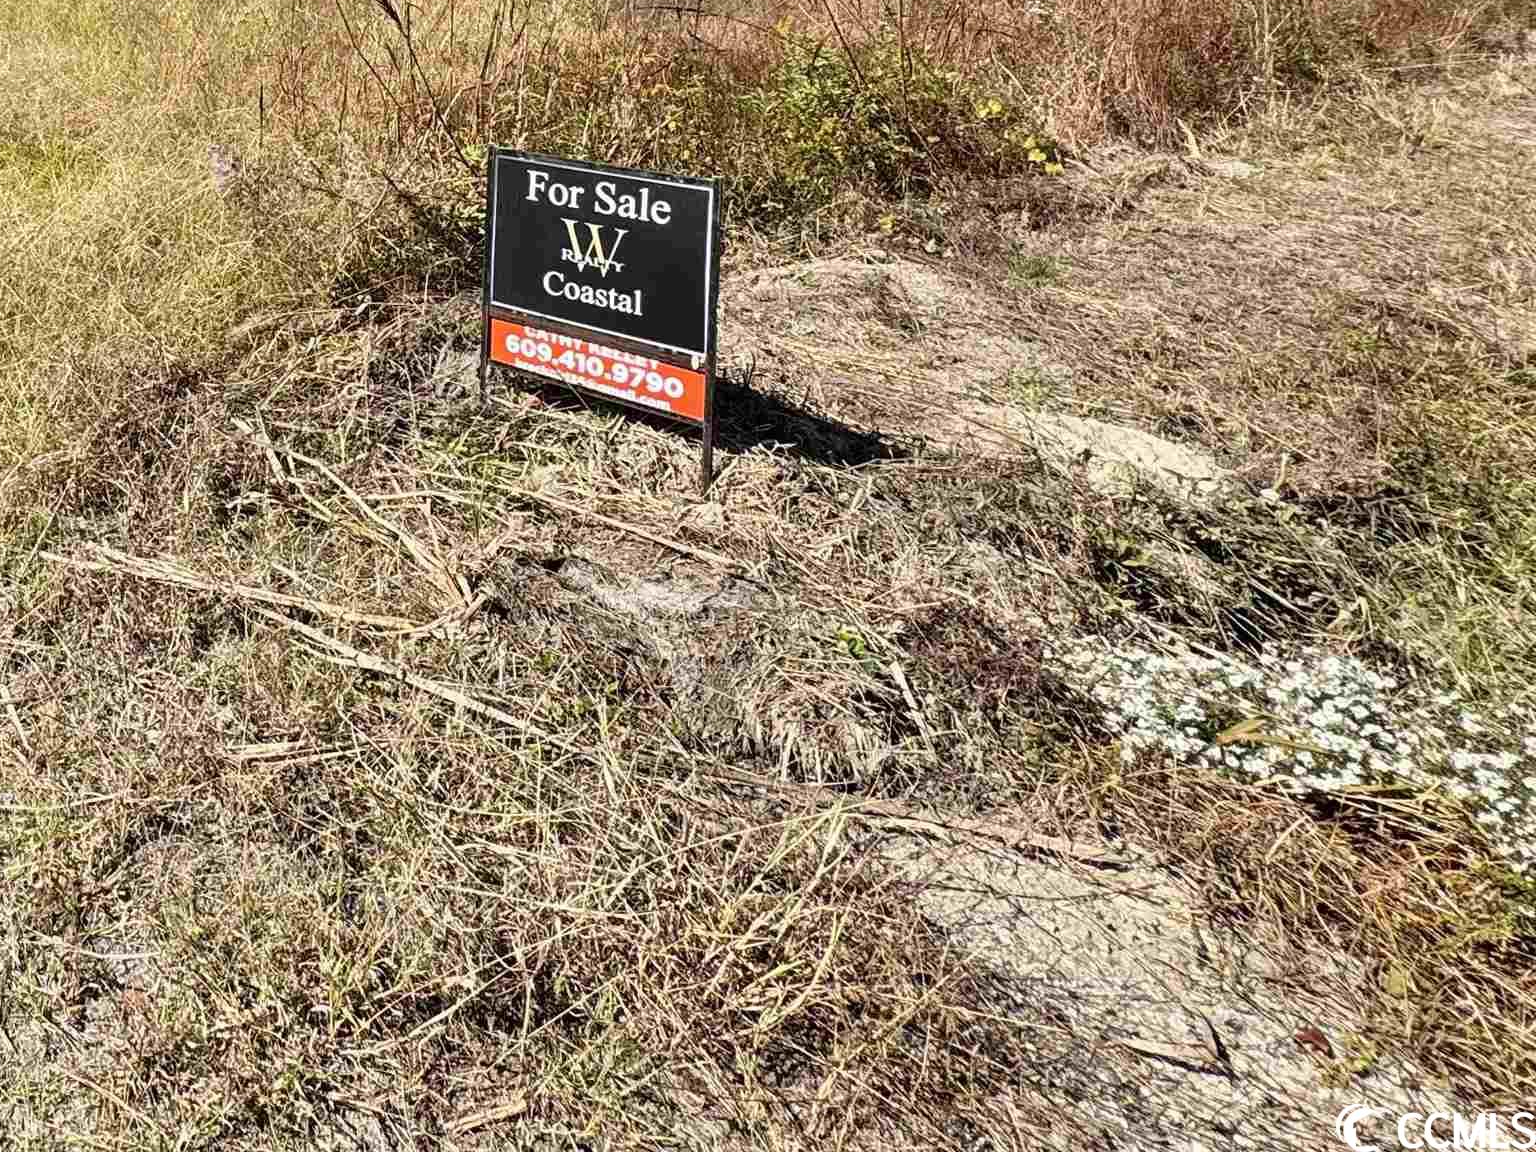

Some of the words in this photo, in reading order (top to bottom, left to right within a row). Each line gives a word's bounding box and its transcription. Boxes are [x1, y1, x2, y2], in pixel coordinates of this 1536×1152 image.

[525, 169, 585, 209] For
[594, 181, 672, 225] Sale
[543, 271, 644, 316] Coastal
[505, 333, 684, 399] 609.410.9790
